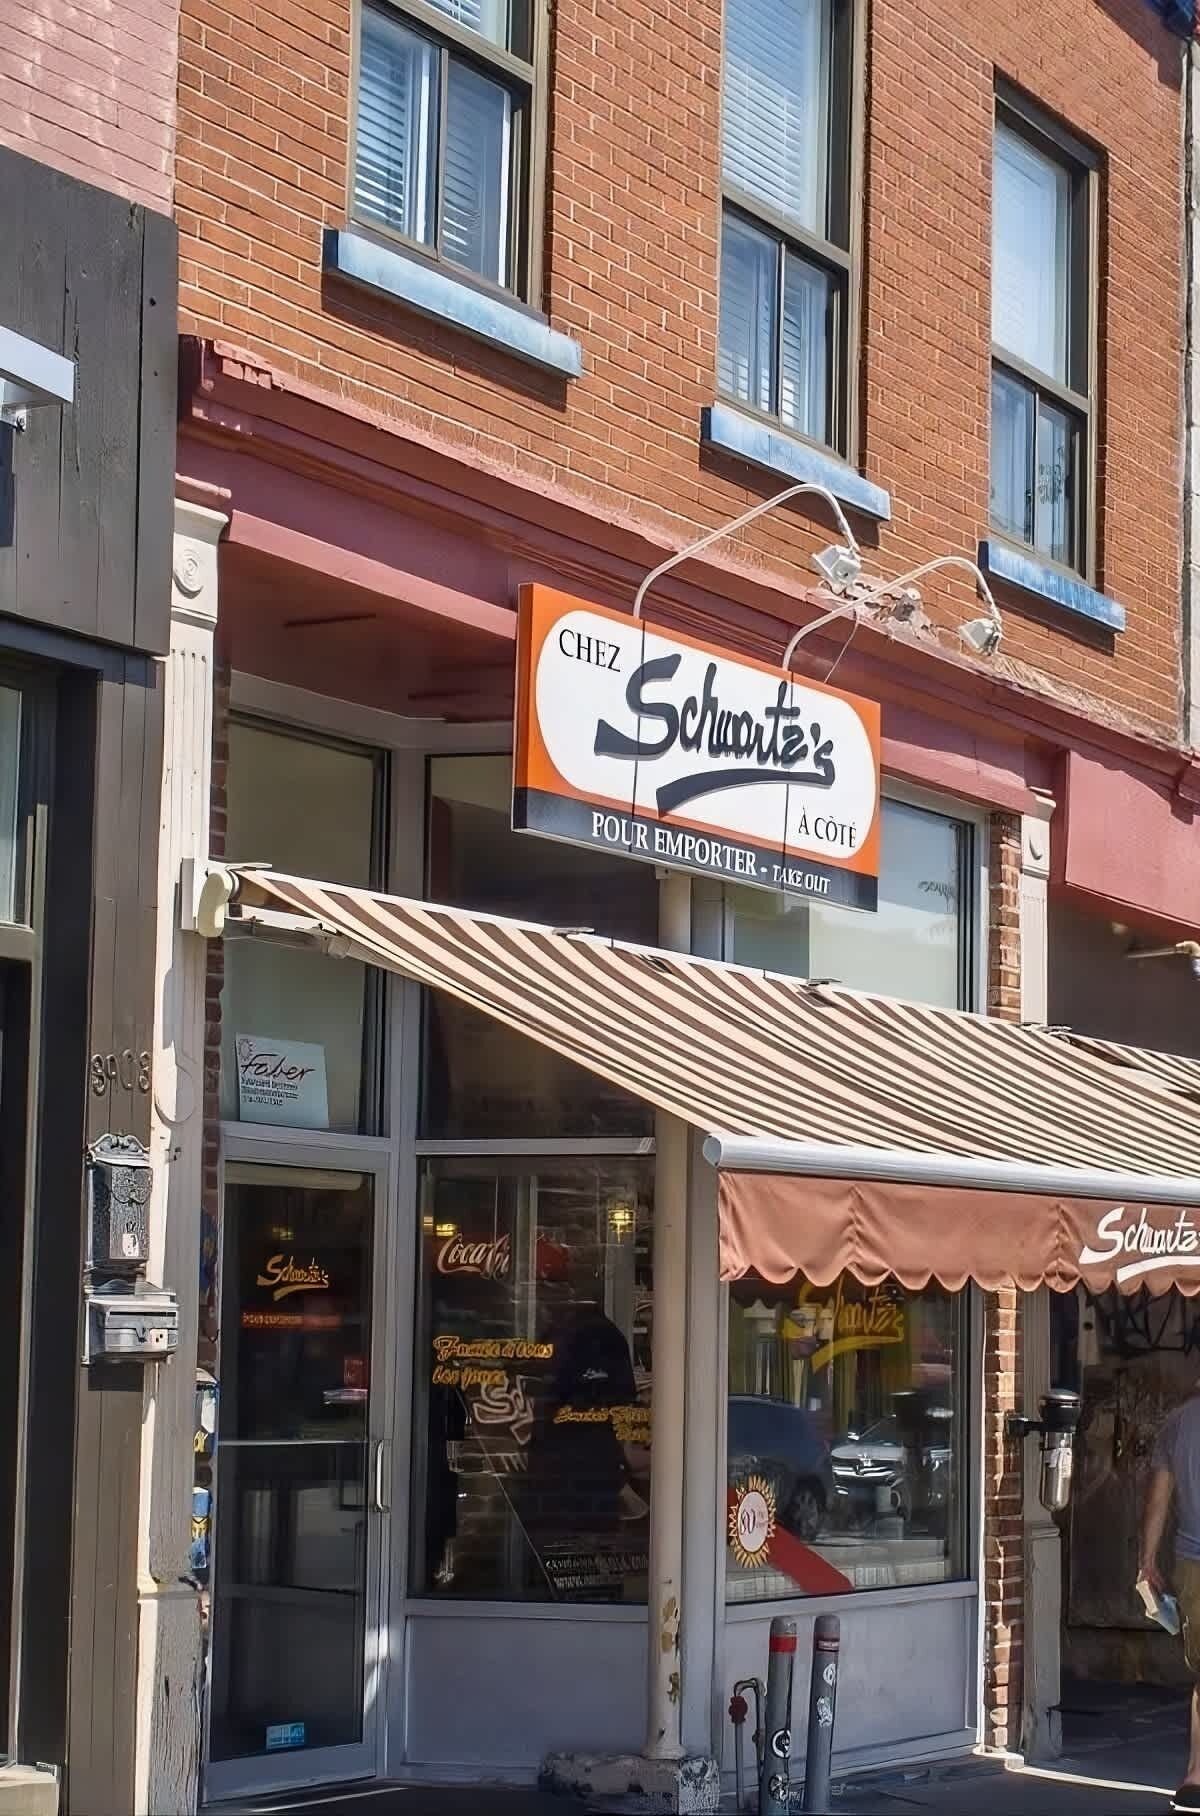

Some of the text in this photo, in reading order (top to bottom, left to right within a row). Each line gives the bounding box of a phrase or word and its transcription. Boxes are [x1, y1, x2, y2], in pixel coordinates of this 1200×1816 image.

[559, 629, 622, 673] CHEZ
[593, 653, 835, 817] Schwartz's
[591, 811, 831, 895] POUR EMPORTER TAKE OUT
[814, 815, 858, 849] CÔTÉ
